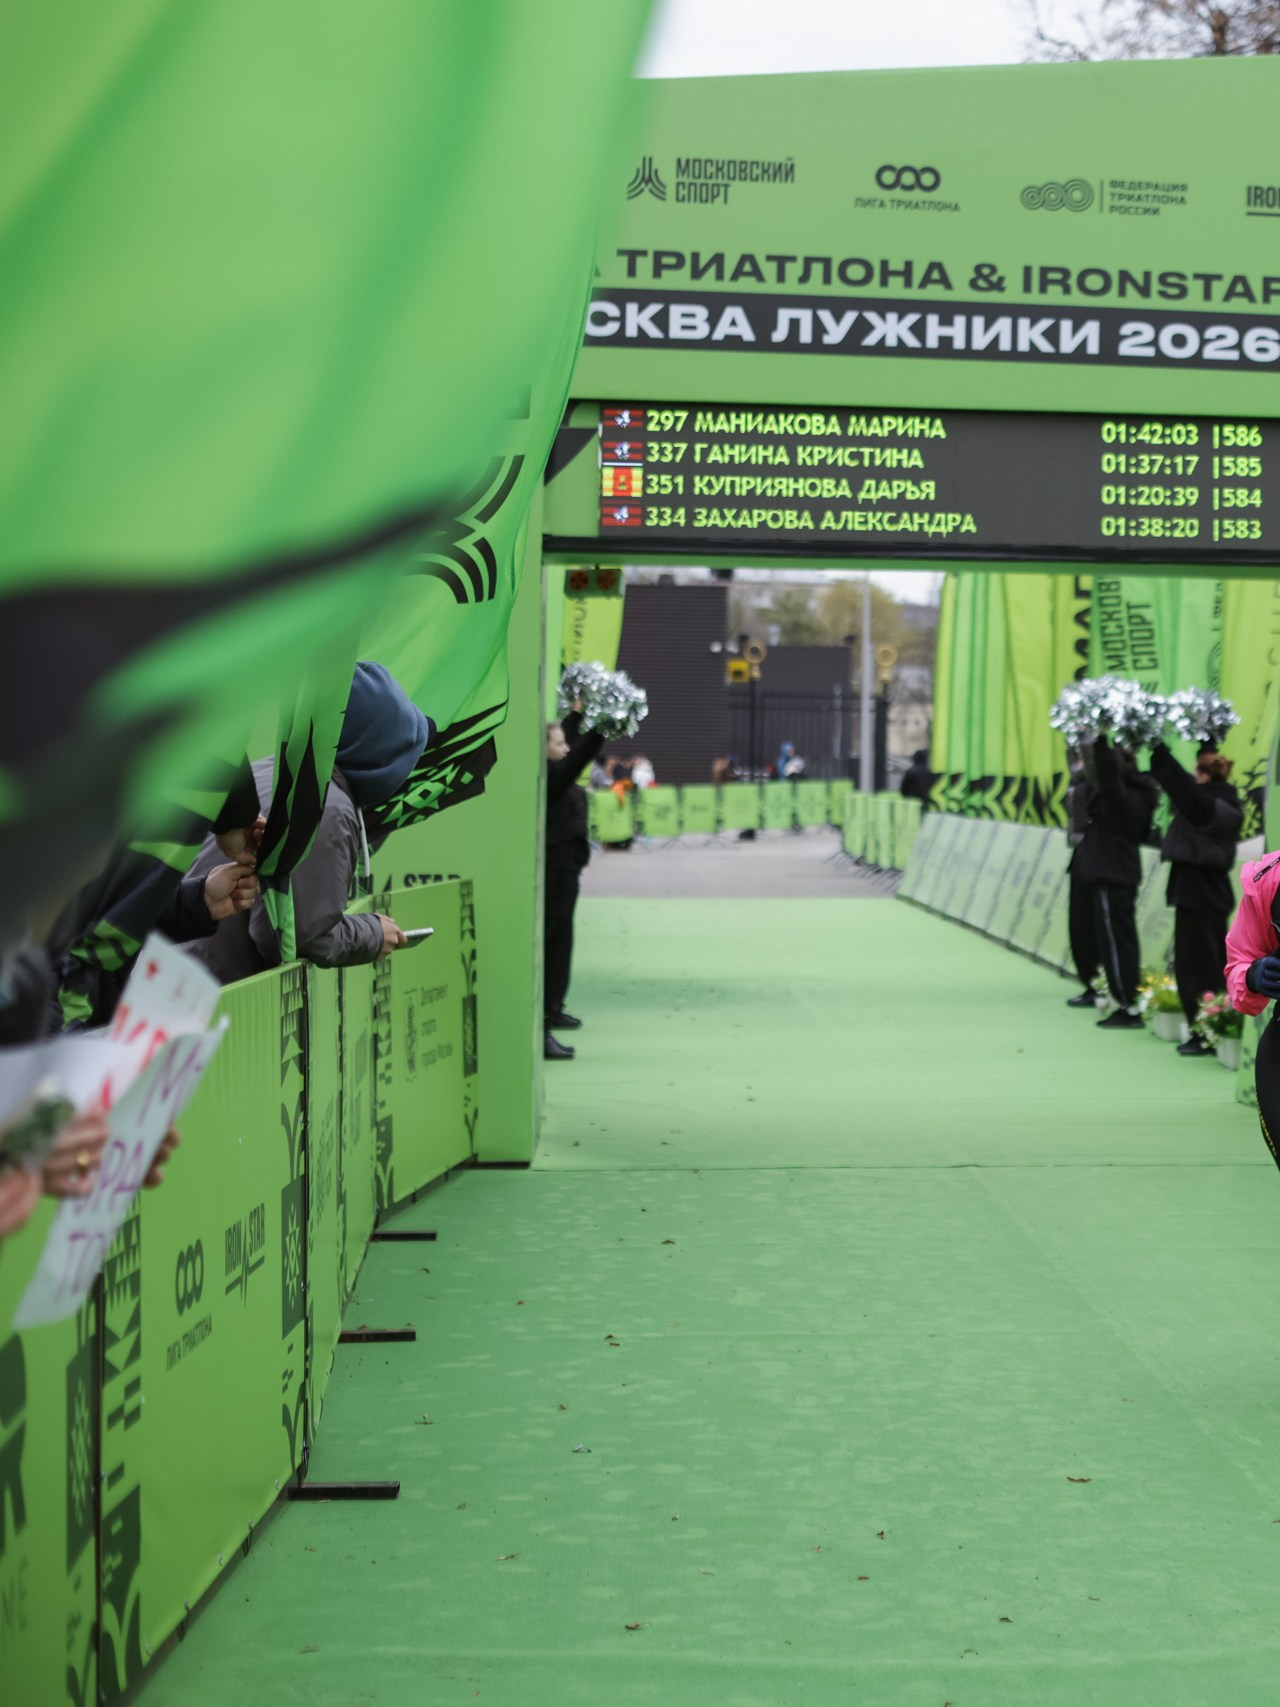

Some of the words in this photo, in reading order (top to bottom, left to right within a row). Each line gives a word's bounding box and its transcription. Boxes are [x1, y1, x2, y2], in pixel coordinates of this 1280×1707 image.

[675, 156, 796, 184] МОСКОВСКИЙ
[675, 182, 731, 205] СПОРТ
[1109, 180, 1189, 192] ФЕДЕРАЦИЯ
[1109, 192, 1187, 205] ТРИАТЛОНА
[854, 197, 886, 209] ЛИГА
[889, 199, 961, 212] ТРИАТЛОНА
[1109, 205, 1160, 216] РОССИИ
[616, 248, 954, 291] ТРИАТЛОНА
[968, 262, 1007, 294] &
[770, 306, 1101, 355] ЛУЖНИКИ
[646, 410, 689, 432] 297
[694, 411, 842, 436] МАНИАКОВА
[847, 415, 947, 440] МАРИНА
[1100, 421, 1200, 445] 01:42:03
[646, 442, 688, 463] 337
[693, 442, 790, 466] ГАНИНА
[797, 444, 925, 469] КРИСТИНА
[1100, 453, 1200, 476] 01:37:17
[646, 475, 684, 496] 351
[693, 475, 852, 500] КУПРИЯНОВА
[857, 479, 936, 505] ДАРЬЯ
[1100, 485, 1200, 507] 01:20:39
[645, 507, 686, 528] 334
[693, 507, 815, 531] ЗАХАРОВА
[820, 509, 978, 538] АЛЕКСАНДРА
[1100, 516, 1200, 538] 01:38:20
[1125, 601, 1159, 672] СПОРТ
[225, 1219, 242, 1277] IRON
[249, 1202, 265, 1258] STAR
